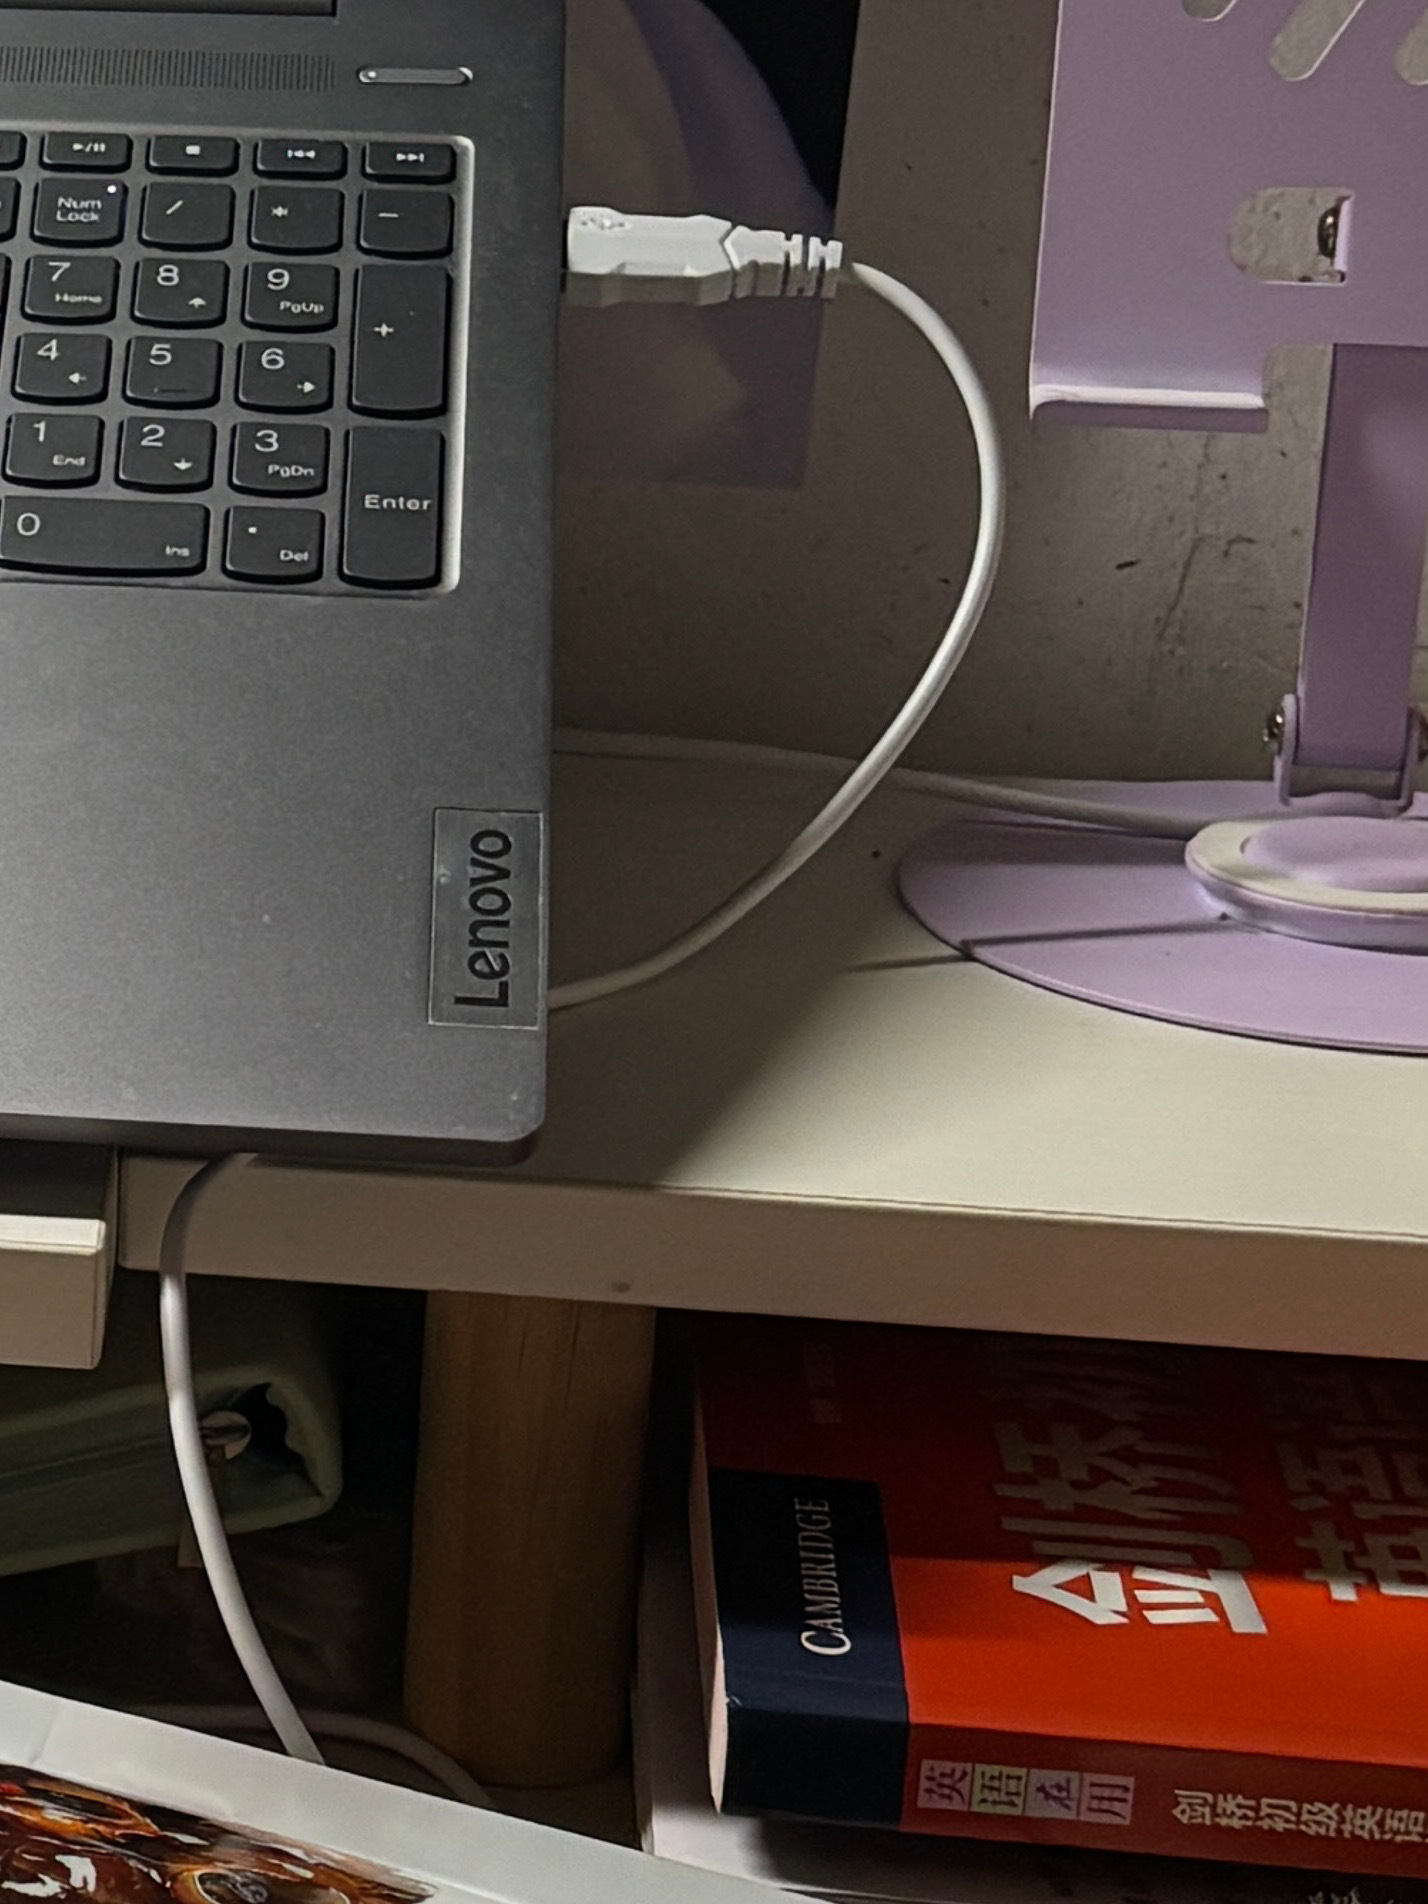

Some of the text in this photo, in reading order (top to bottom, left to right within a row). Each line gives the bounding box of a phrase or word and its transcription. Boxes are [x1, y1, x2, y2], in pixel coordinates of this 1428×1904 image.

[57, 198, 102, 211] Num
[55, 209, 100, 223] Lock
[49, 262, 70, 281] 7
[157, 265, 179, 285] 8
[268, 269, 289, 289] 9
[38, 339, 58, 360] 4
[150, 344, 171, 365] 5
[262, 348, 284, 369] 6
[34, 422, 45, 441] 1
[141, 425, 164, 446] 2
[255, 430, 278, 451] 3
[53, 455, 85, 465] End
[365, 495, 430, 509] Enter
[17, 513, 40, 535] 0
[280, 550, 308, 561] Del
[453, 829, 512, 1007] Lenovo
[793, 1495, 852, 1656] CAMBRIDGE
[920, 1760, 1134, 1824] 英语在用
